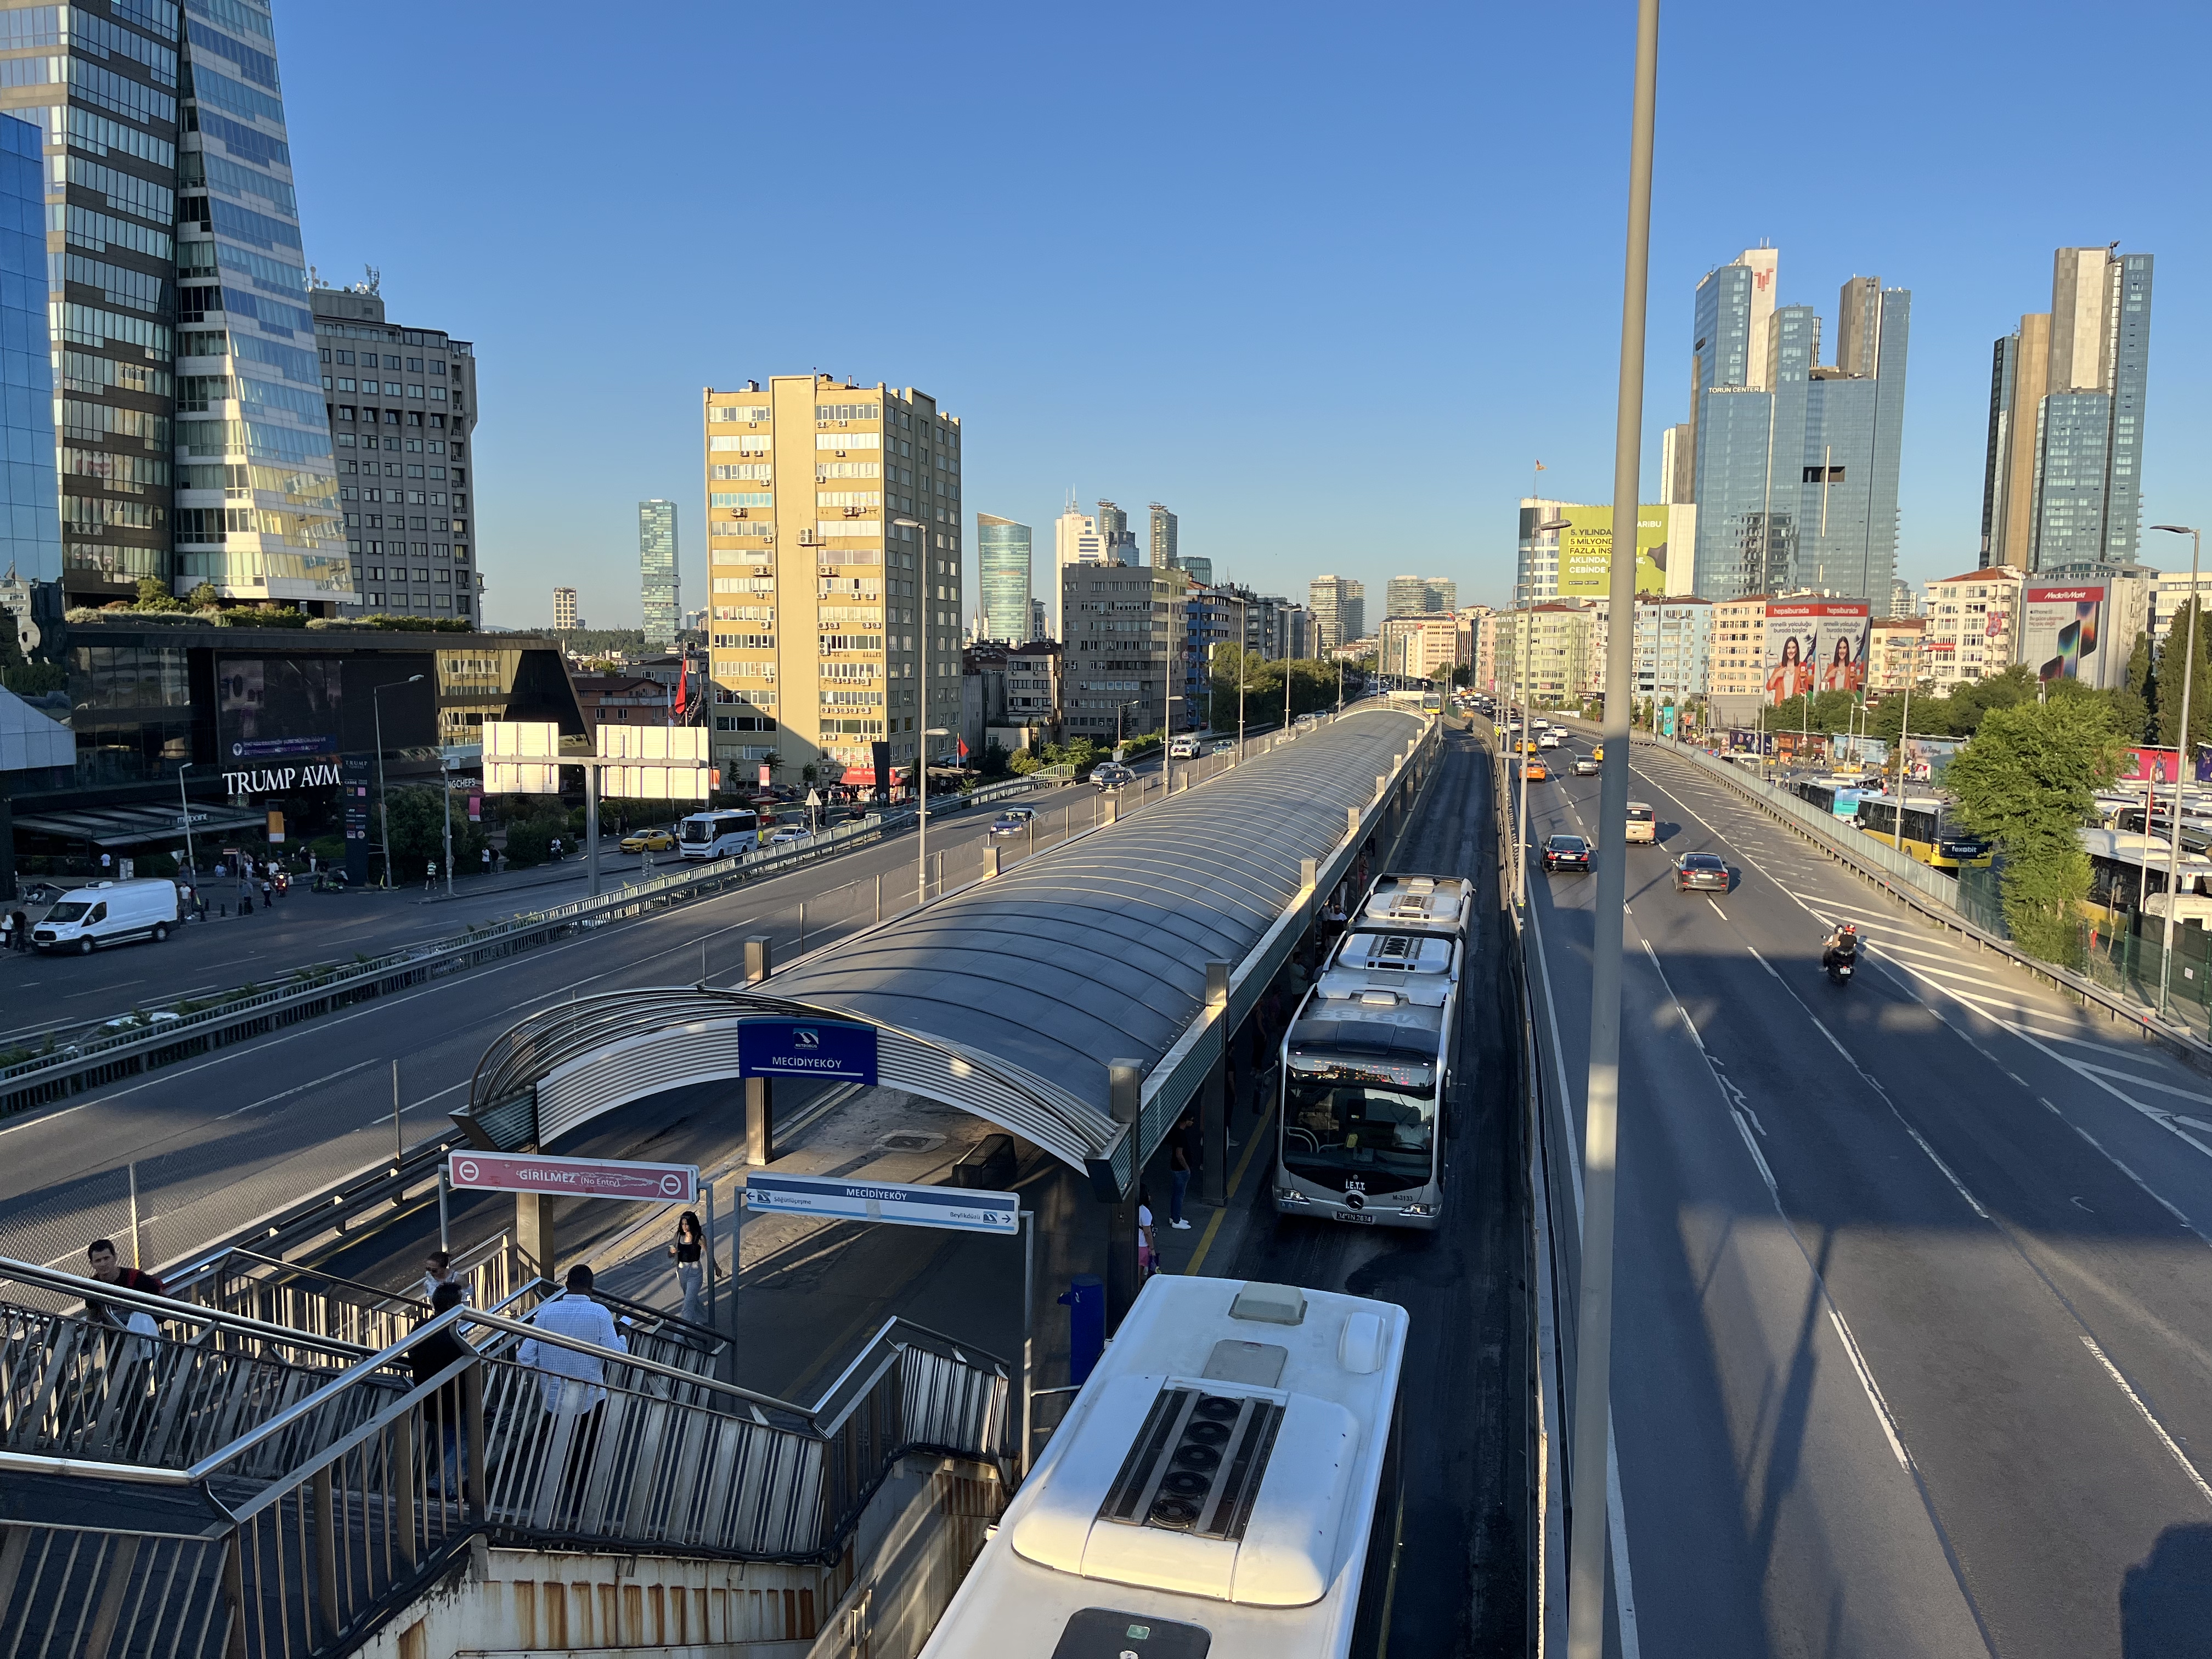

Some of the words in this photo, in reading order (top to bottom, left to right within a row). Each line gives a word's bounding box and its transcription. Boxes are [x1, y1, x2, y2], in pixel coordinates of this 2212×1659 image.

[1599, 546, 1612, 554] İNS
[1569, 565, 1606, 573] CEBİNDE
[1774, 607, 1809, 616] hepsiburada
[1827, 607, 1859, 615] hepsiburada
[222, 768, 296, 795] TRUMP
[300, 764, 341, 788] AVM
[772, 1055, 842, 1068] MECİDİYEKÖY
[519, 1169, 576, 1184] GİRİLMEZ
[580, 1176, 595, 1186] (No
[596, 1177, 620, 1188] Entry)
[846, 1187, 907, 1201] MECİDİYEKÖY
[774, 1196, 812, 1205] Söğütlüçeşme
[950, 1212, 980, 1220] Beylikdüzü
